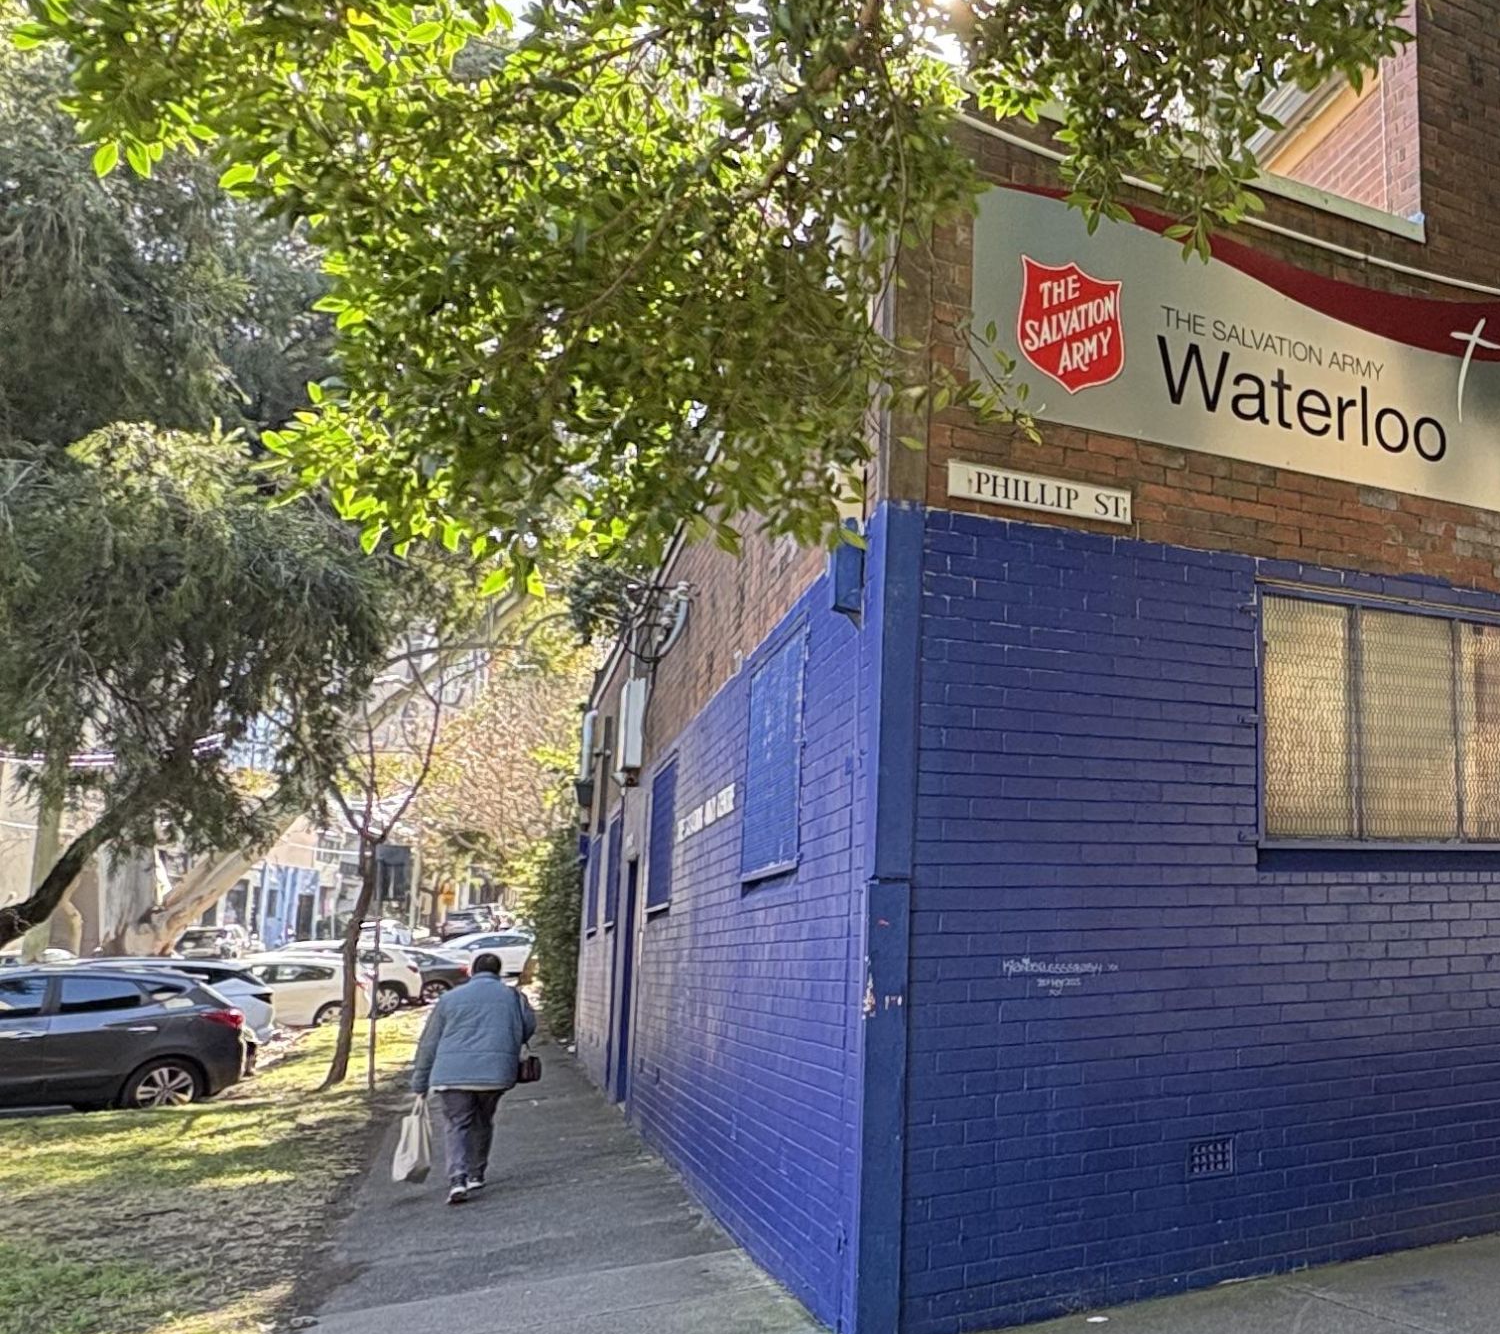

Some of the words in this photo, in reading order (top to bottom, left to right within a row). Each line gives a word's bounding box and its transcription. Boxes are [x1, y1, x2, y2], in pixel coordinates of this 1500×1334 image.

[1039, 274, 1081, 309] THE
[1024, 290, 1115, 351] SALVATION
[1160, 305, 1206, 336] THE
[1212, 320, 1323, 366] SALVATION
[1328, 351, 1384, 381] ARMY
[1057, 326, 1112, 376] ARMY
[1157, 334, 1447, 463] Waterloo
[975, 471, 1079, 510] PHILLIP
[1094, 492, 1126, 518] ST
